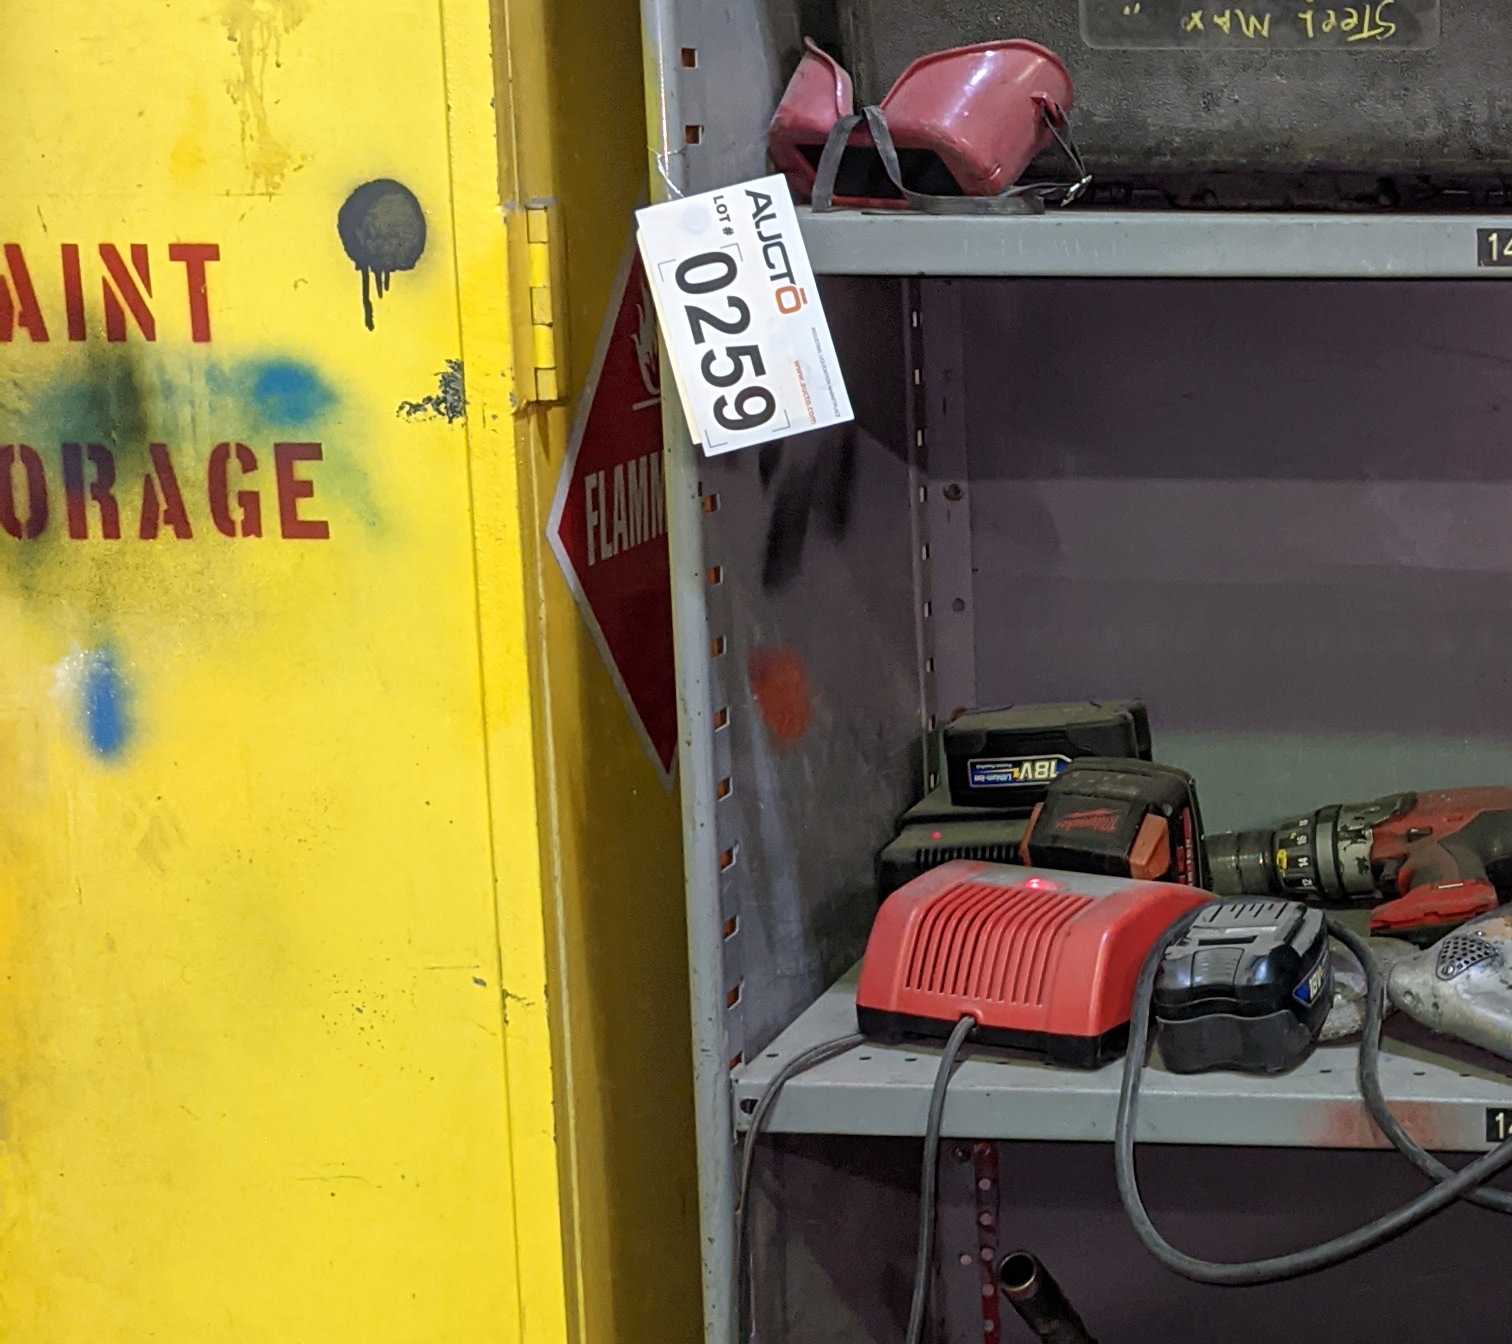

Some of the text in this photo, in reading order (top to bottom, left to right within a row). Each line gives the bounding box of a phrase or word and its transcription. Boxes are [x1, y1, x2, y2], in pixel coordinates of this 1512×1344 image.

[713, 194, 735, 237] LOT #
[0, 242, 220, 343] AINT
[675, 251, 776, 431] 0259
[0, 442, 331, 541] ORAGE
